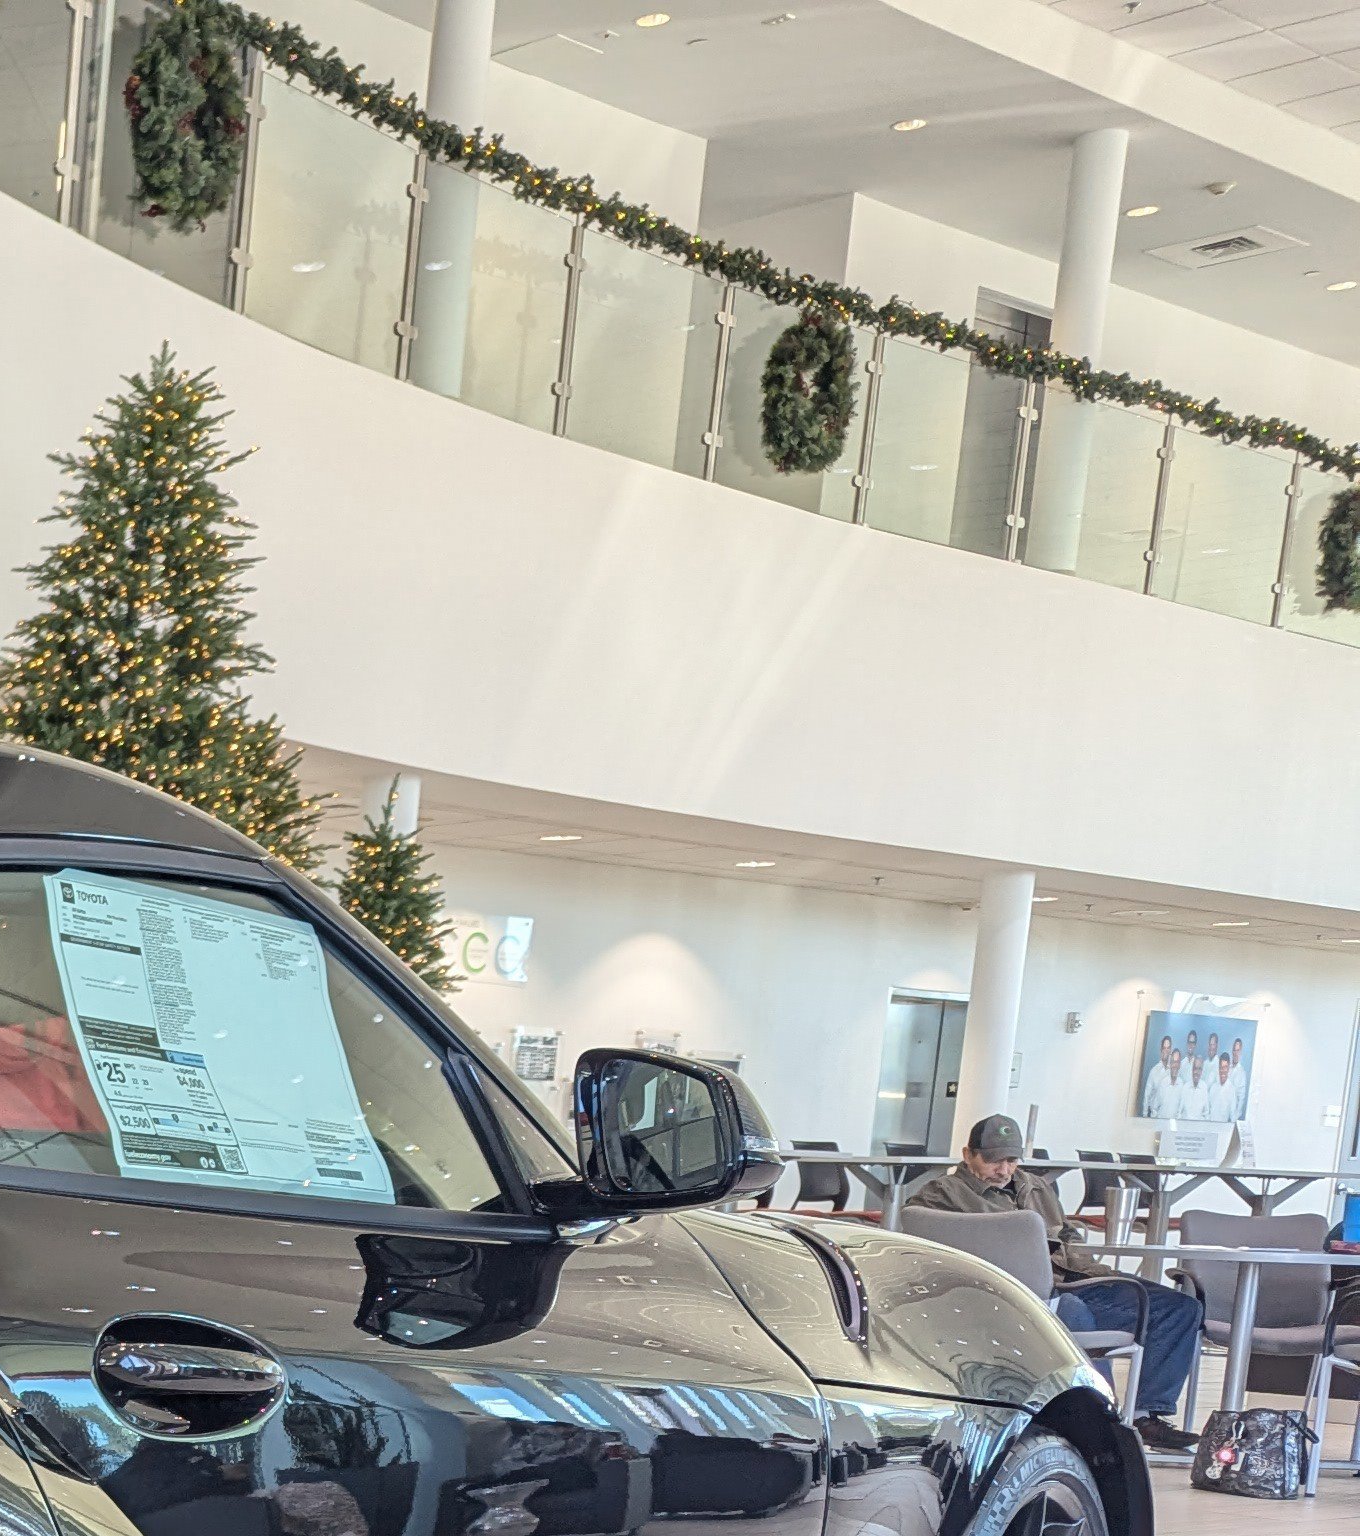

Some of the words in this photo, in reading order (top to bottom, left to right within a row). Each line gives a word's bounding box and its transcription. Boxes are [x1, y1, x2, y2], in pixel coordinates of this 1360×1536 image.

[76, 889, 109, 906] TOYOTA
[102, 1061, 126, 1084] 25
[1019, 1447, 1066, 1481] MICHELIN
